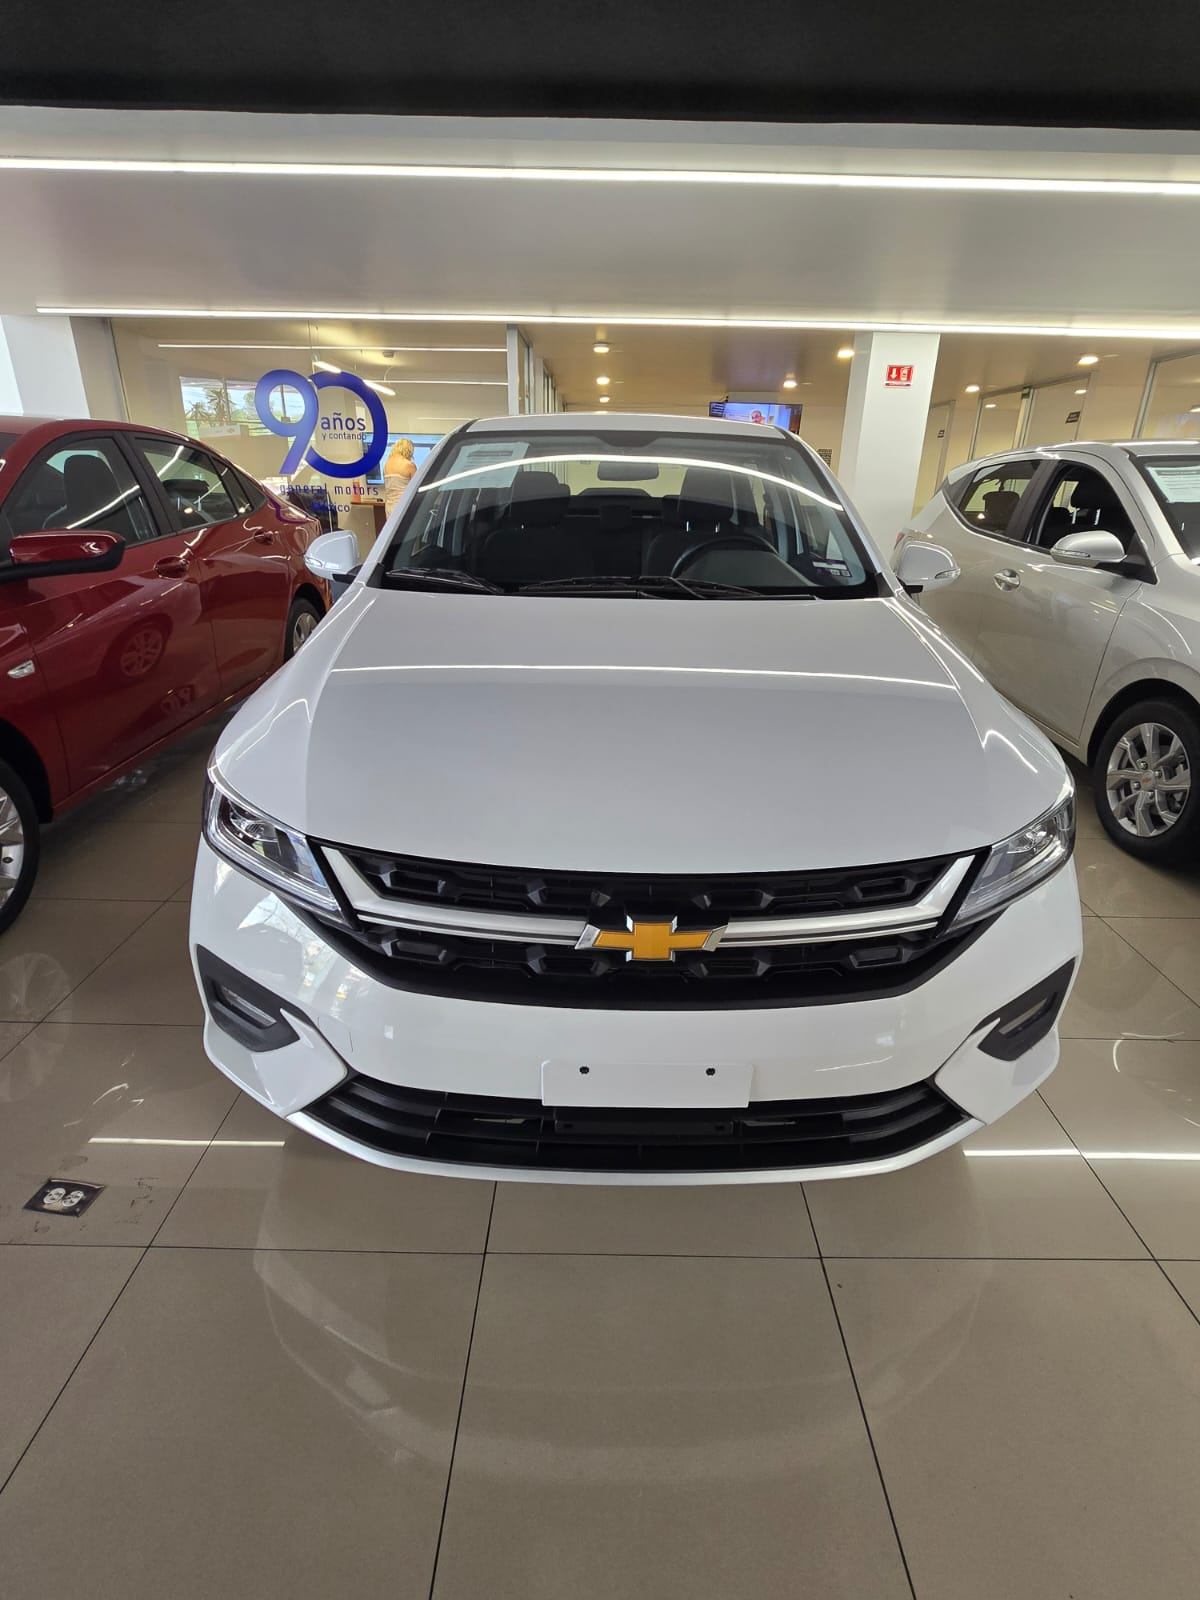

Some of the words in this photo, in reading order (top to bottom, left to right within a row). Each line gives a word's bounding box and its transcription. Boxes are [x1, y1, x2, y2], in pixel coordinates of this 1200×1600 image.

[255, 369, 388, 478] 90
[321, 412, 366, 431] años
[321, 433, 327, 441] y
[329, 432, 367, 441] contando
[279, 483, 328, 495] general
[334, 484, 379, 496] motors
[311, 501, 350, 512] xico
